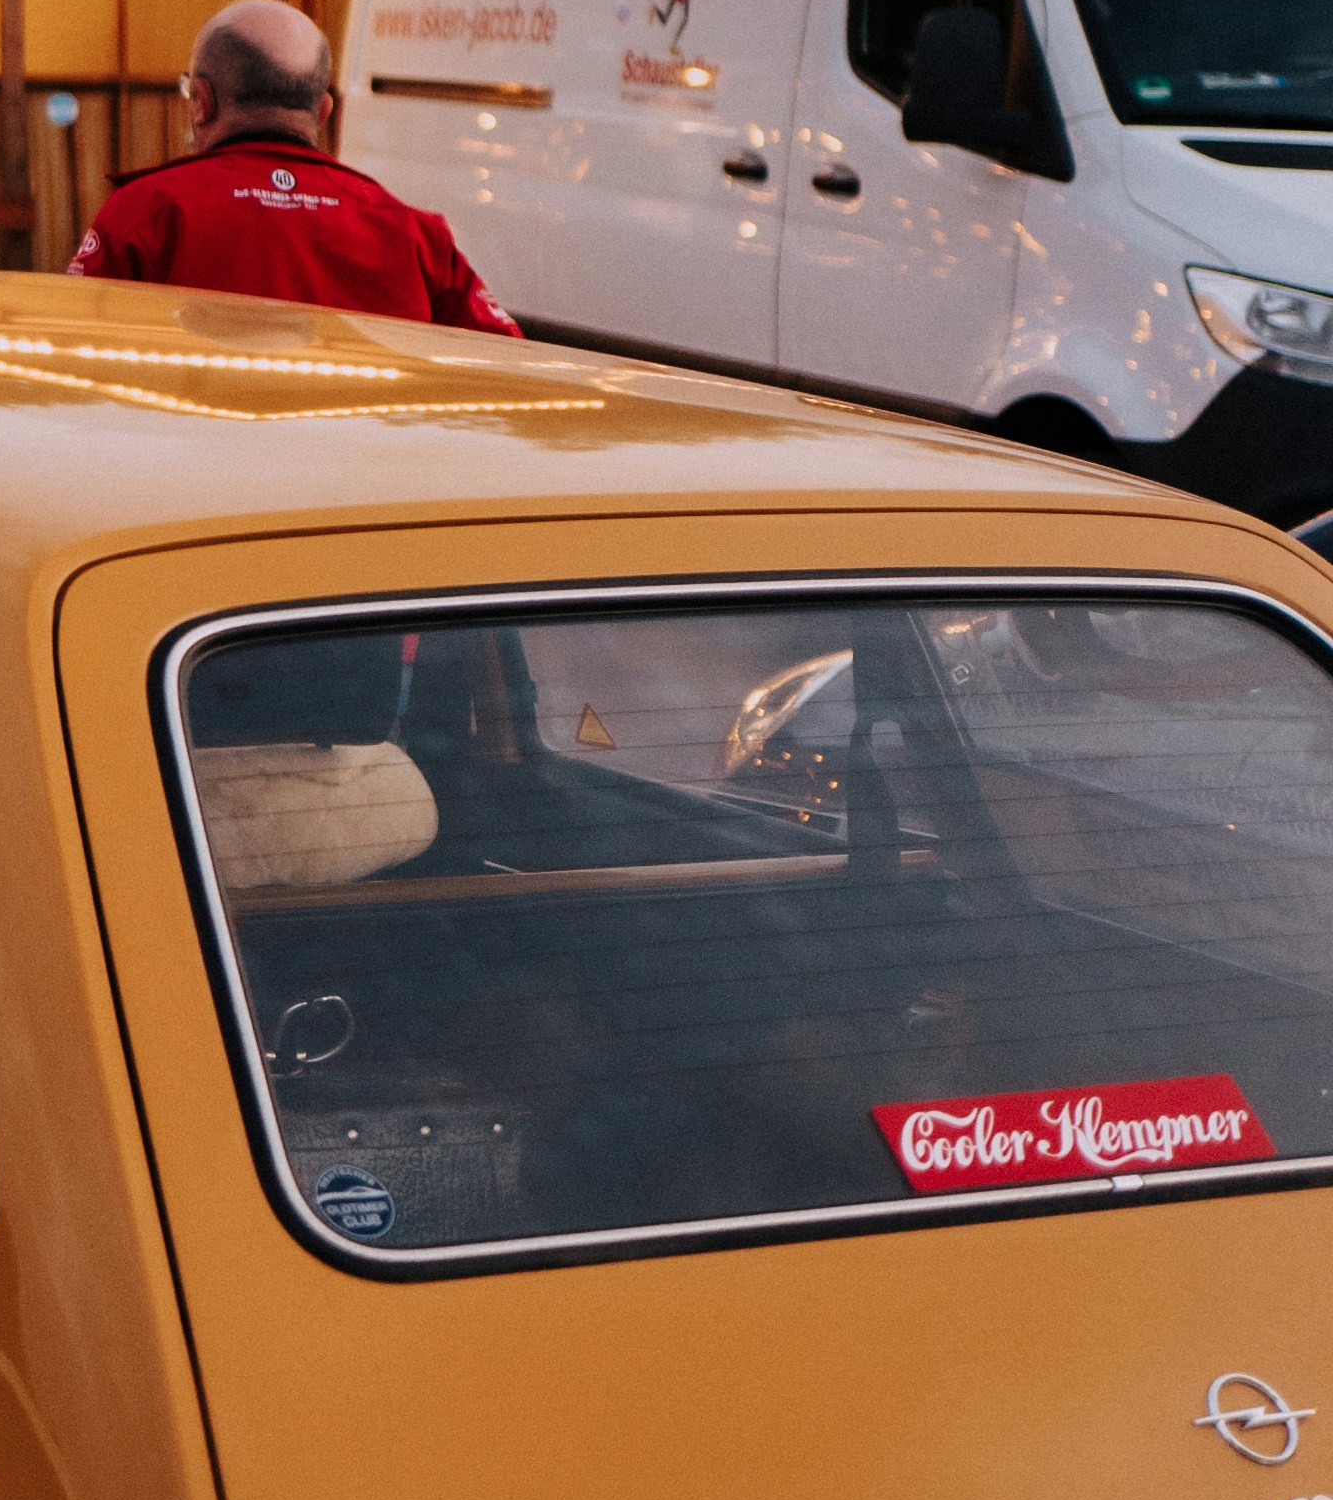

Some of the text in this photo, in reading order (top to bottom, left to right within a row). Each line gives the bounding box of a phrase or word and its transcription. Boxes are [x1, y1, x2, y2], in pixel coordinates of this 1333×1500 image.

[276, 171, 291, 186] 40
[900, 1095, 1248, 1171] Cooler Klempner
[343, 1213, 383, 1228] CLUB
